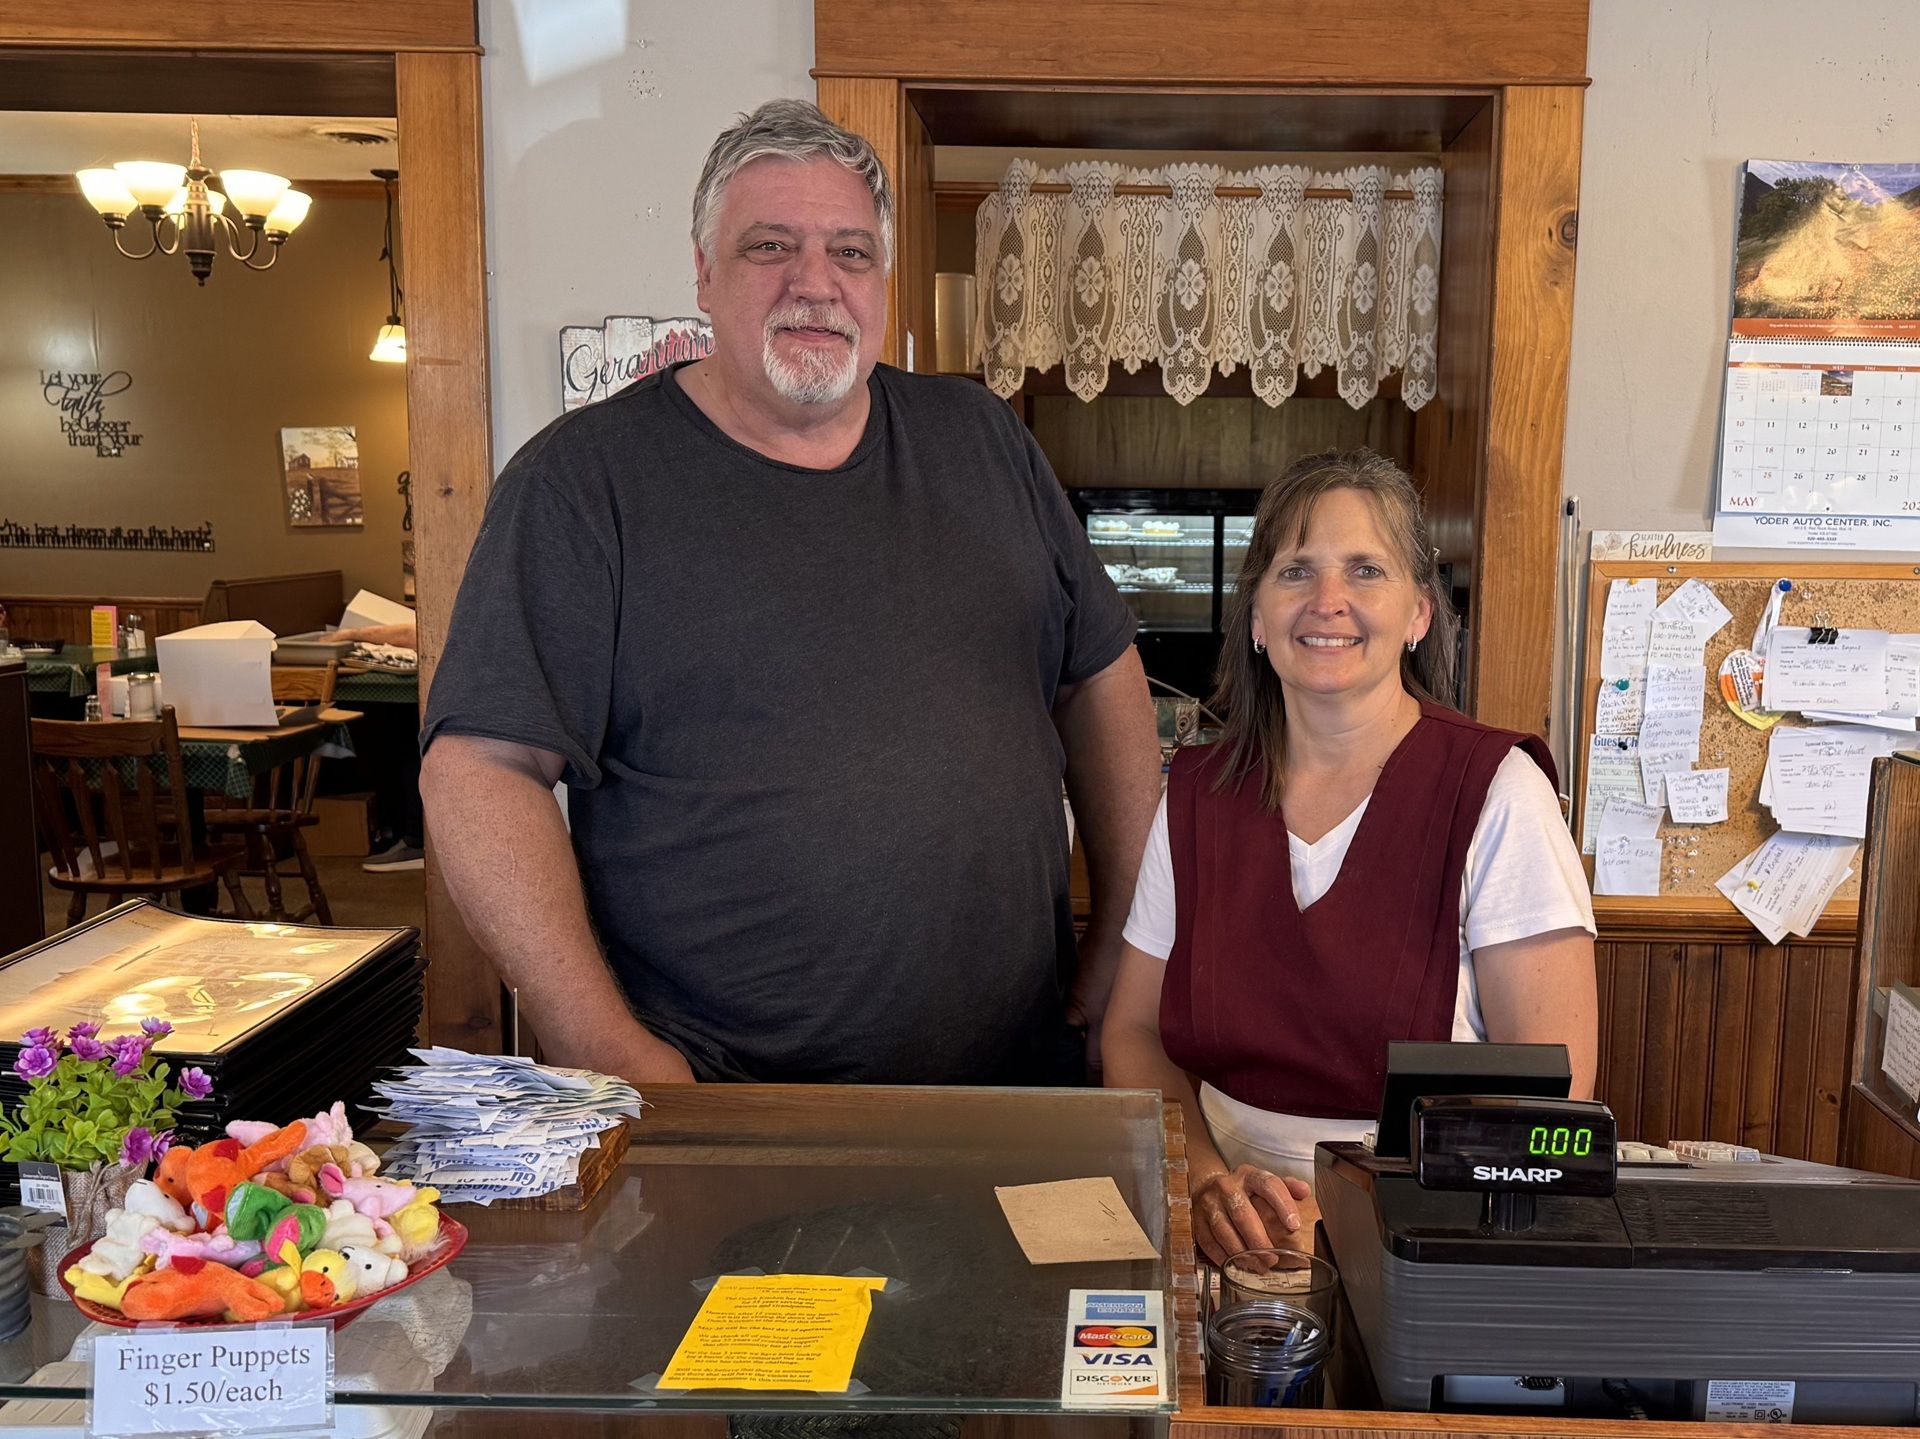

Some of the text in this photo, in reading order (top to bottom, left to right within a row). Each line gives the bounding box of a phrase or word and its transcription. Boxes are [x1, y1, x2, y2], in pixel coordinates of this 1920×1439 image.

[68, 373, 102, 391] your
[1729, 496, 1757, 507] MAY
[1901, 501, 1920, 511] 202
[1754, 516, 1789, 525] YODER
[1793, 517, 1823, 526] AUTO
[1873, 519, 1893, 527] INC.
[1623, 533, 1707, 560] kindness
[1529, 1127, 1592, 1156] 0.00
[1473, 1165, 1563, 1183] SHARP
[1080, 1332, 1151, 1340] MasterCard
[118, 1345, 310, 1375] Finger Puppets
[1080, 1353, 1153, 1366] VISA
[144, 1378, 283, 1406] $1.50/each
